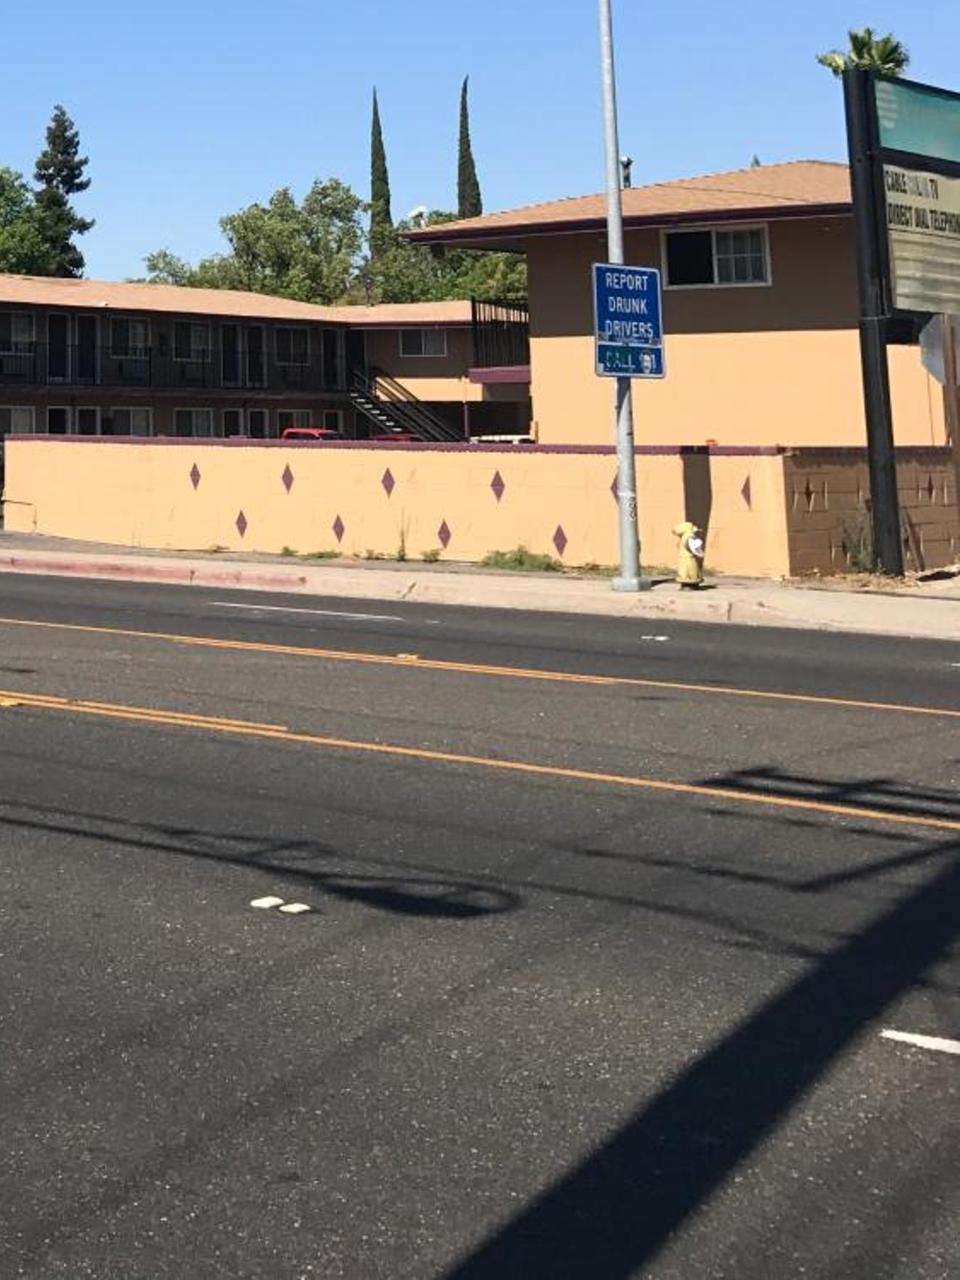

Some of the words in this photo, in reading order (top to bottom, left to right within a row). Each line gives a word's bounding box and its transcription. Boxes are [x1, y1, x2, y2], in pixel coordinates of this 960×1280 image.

[885, 170, 907, 194] CABLE
[887, 203, 913, 227] DIRECT
[605, 272, 648, 291] REPORT
[608, 296, 648, 315] DRUNK
[604, 320, 654, 338] DRIVERS
[605, 352, 636, 369] CALL
